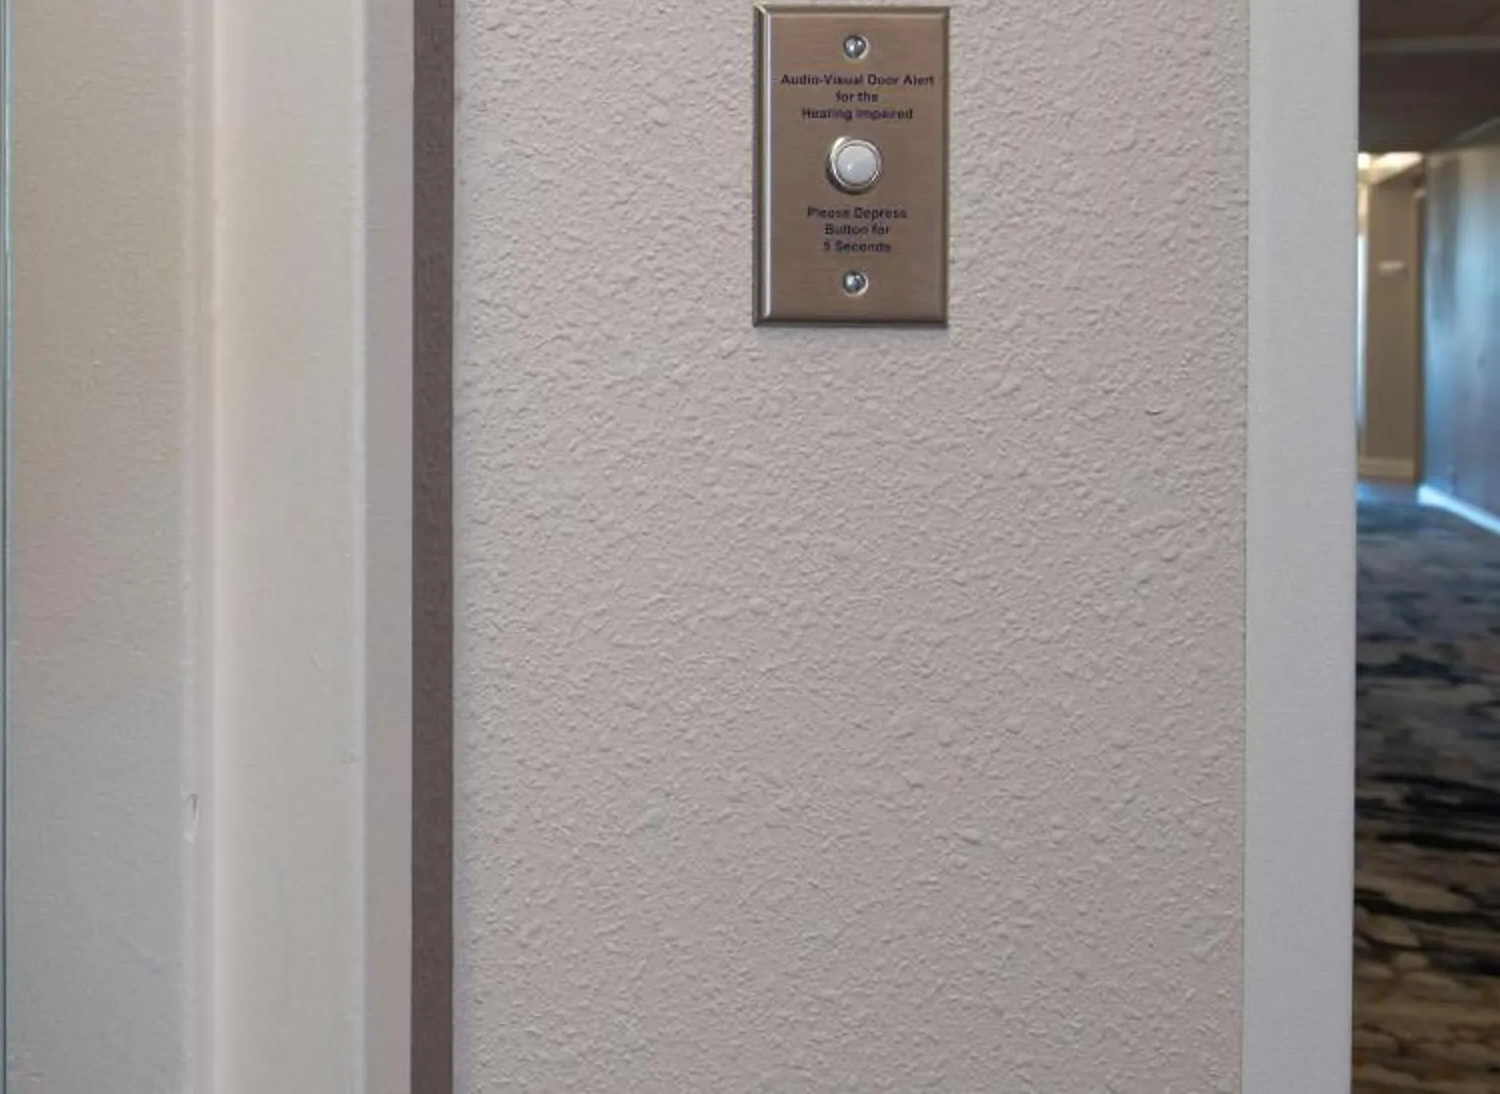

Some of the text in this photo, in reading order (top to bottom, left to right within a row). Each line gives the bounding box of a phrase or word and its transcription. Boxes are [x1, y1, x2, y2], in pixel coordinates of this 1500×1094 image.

[780, 73, 935, 87] Audio-Visual Door Alert
[835, 90, 879, 102] for the
[801, 108, 913, 121] Hearing Impaired
[807, 206, 907, 221] Please Depress
[824, 224, 891, 236] Button for
[834, 241, 892, 253] Seconds
